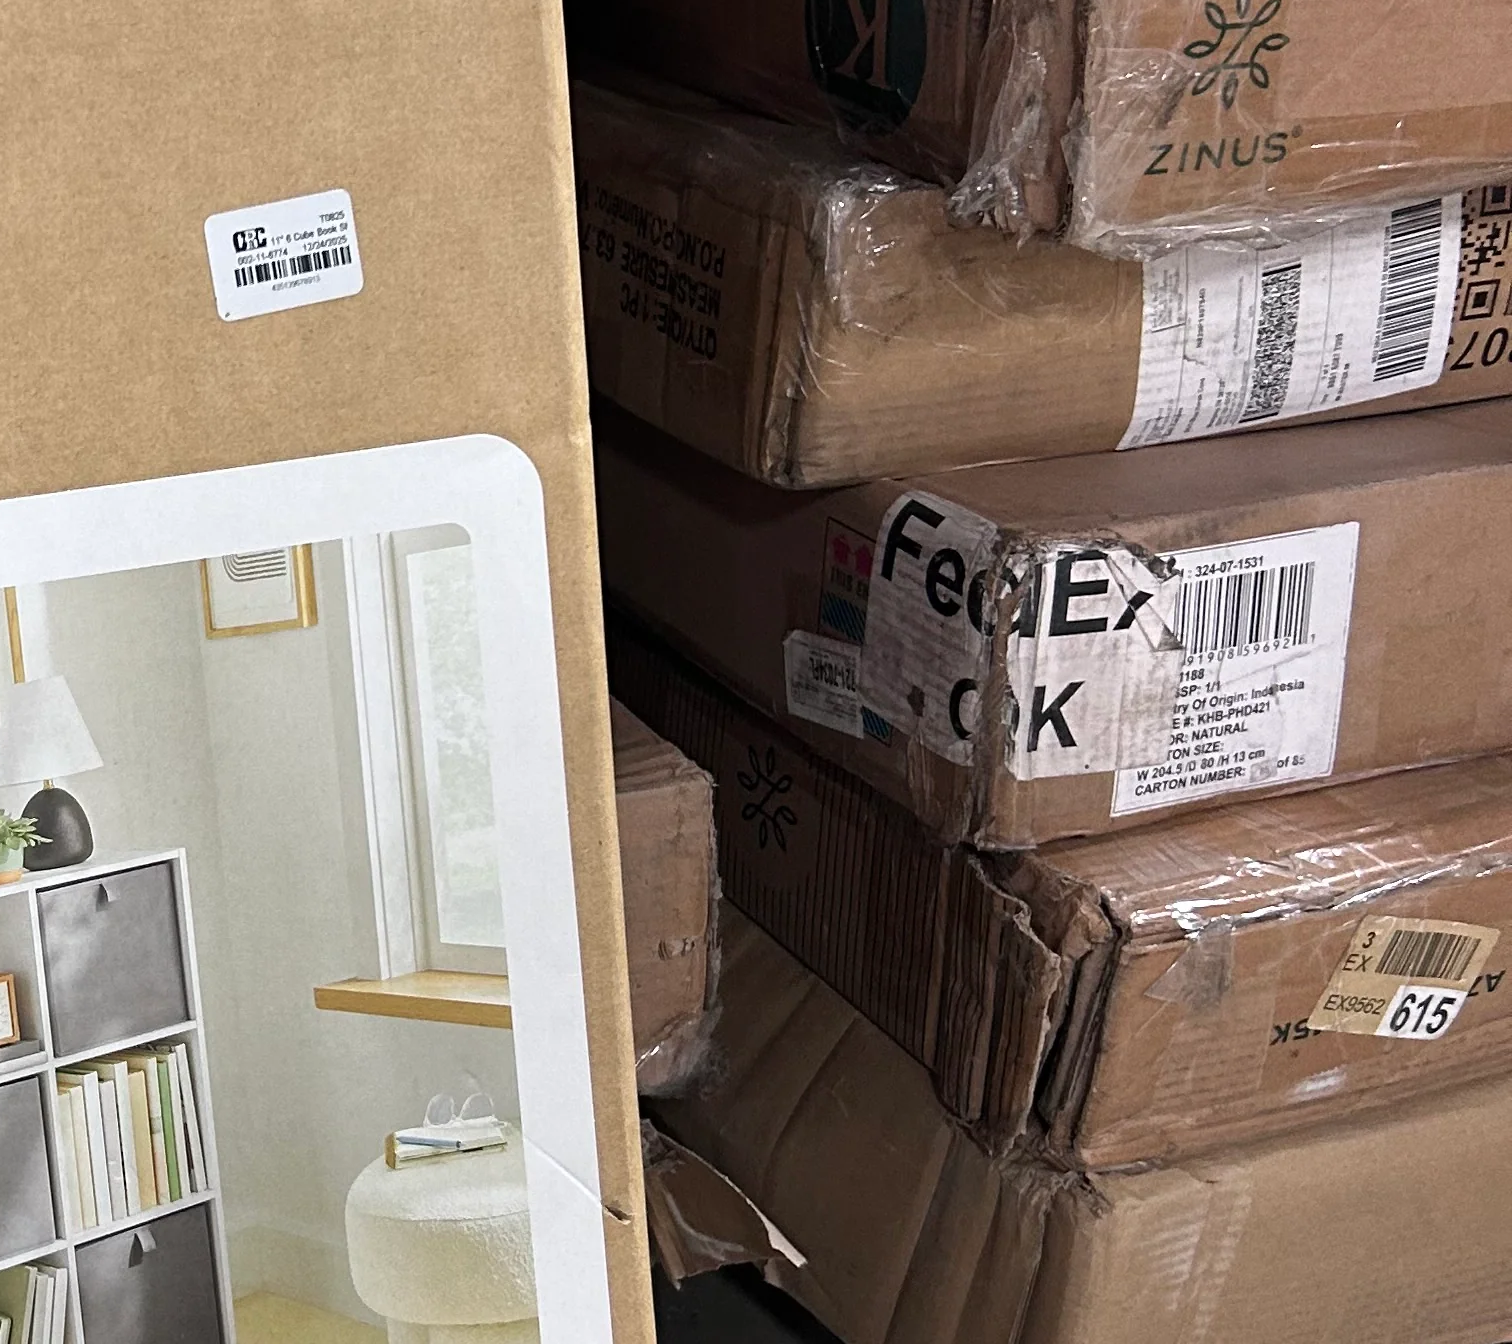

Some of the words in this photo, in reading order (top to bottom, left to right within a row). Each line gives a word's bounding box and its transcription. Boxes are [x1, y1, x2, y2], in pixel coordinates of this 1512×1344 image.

[1144, 131, 1289, 175] ZINUS
[1195, 555, 1264, 577] 324-07-1531
[1187, 647, 1235, 667] 91908
[1243, 638, 1290, 657] 59692
[1193, 698, 1207, 711] Of
[1209, 691, 1248, 707] Origin:
[1197, 701, 1270, 726] KHB-PHD421
[1191, 721, 1248, 742] NATURAL
[1193, 740, 1224, 756] SIZE:
[1137, 768, 1149, 782] W
[1200, 756, 1214, 768] 80
[1233, 750, 1246, 763] 13
[1248, 748, 1265, 760] cm
[1135, 776, 1187, 797] CARTON
[1190, 766, 1246, 786] NUMBER:
[1362, 931, 1376, 949] 3
[1342, 953, 1372, 973] EX
[1323, 994, 1386, 1016] EX9562
[1389, 993, 1457, 1034] 615
